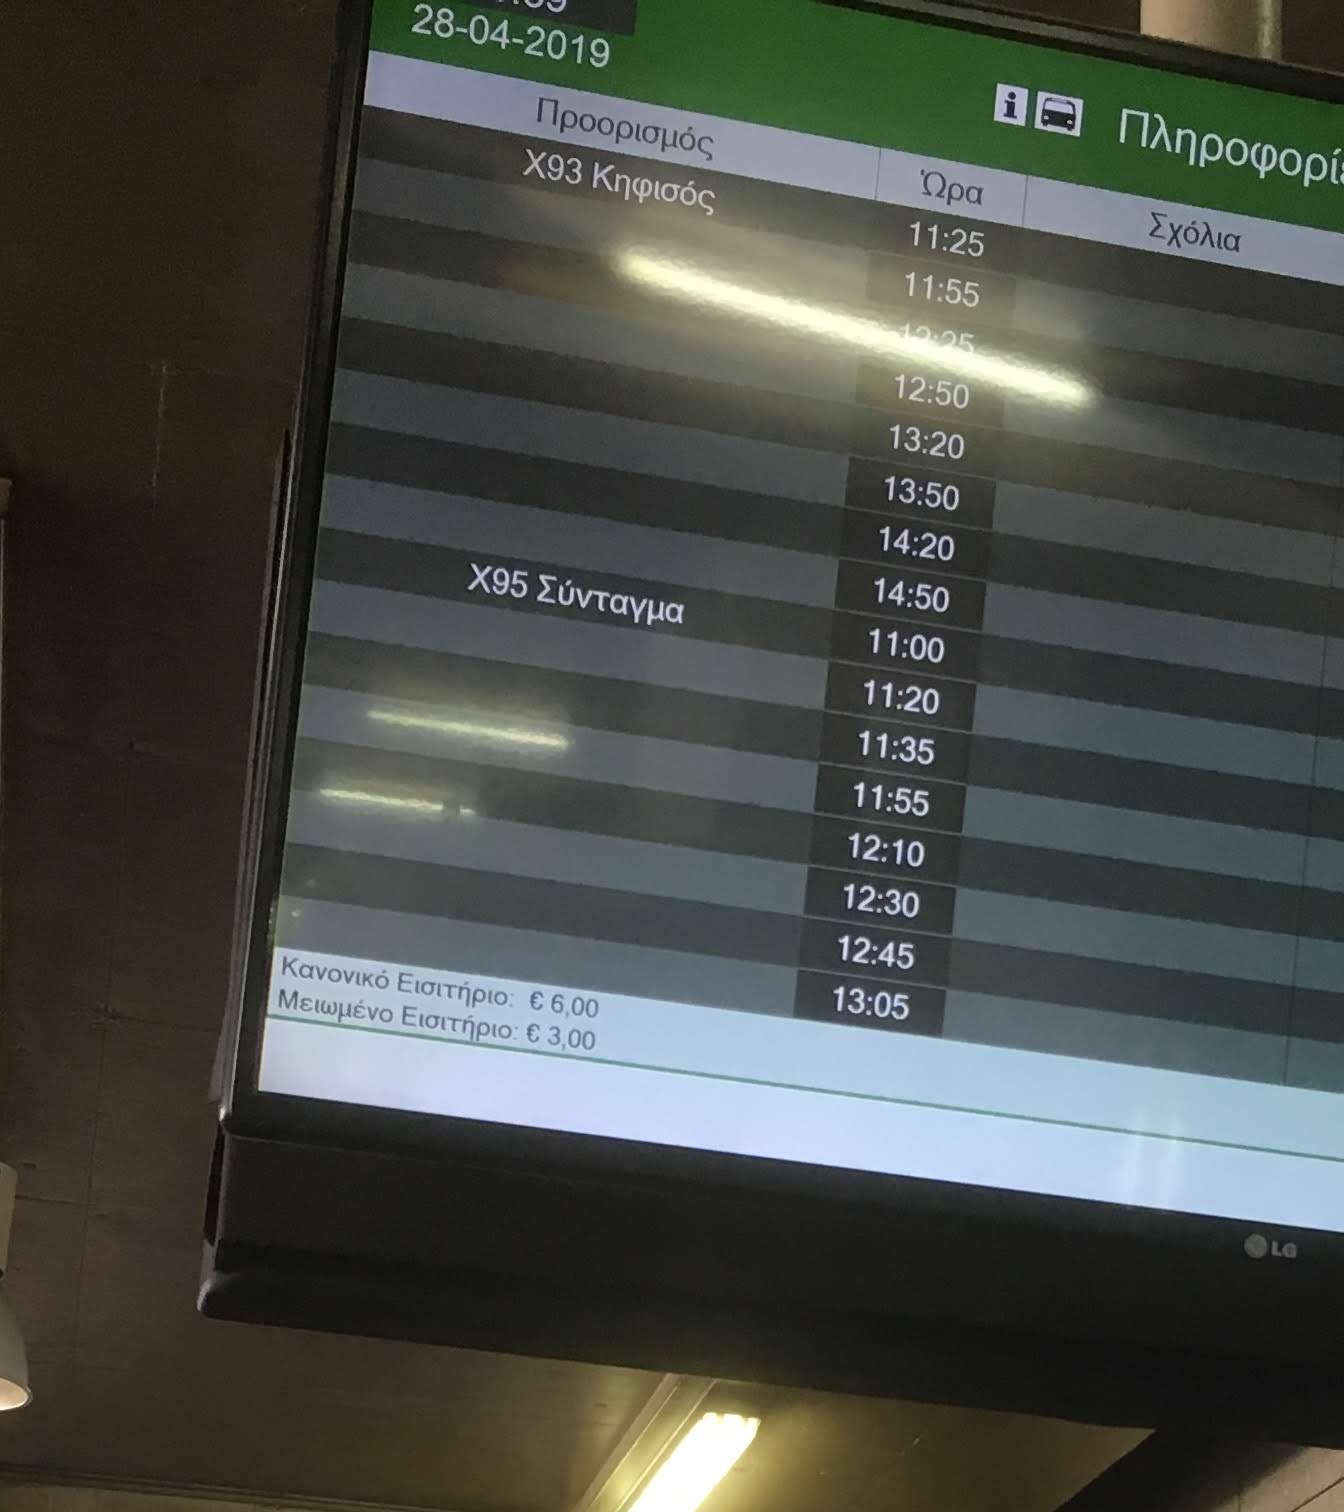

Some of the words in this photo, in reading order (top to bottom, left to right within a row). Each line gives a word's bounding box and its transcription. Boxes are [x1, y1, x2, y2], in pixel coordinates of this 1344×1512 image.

[411, 3, 611, 68] 28-04-2019
[537, 97, 714, 160] Προορισμός
[592, 162, 717, 216] Κηφισός
[920, 169, 984, 206] Ώρα
[909, 221, 985, 257] 11:25
[1149, 212, 1241, 254] Σχόλια
[905, 271, 980, 307] 11:55
[894, 374, 969, 409] 12:50
[889, 424, 965, 459] 13:20
[884, 475, 960, 511] 13:50
[879, 526, 955, 562] 14:20
[536, 574, 685, 626] Σύνταγμα
[873, 577, 950, 613] 14:50
[868, 629, 945, 664] 11:00
[863, 680, 940, 716] 11:20
[858, 730, 936, 767] 11:35
[853, 782, 931, 818] 11:55
[847, 833, 926, 868] 12:10
[842, 883, 920, 919] 12:30
[837, 934, 915, 971] 12:45
[280, 956, 390, 990] Κανονικό
[396, 973, 514, 1010] Εισιτήριο:
[550, 993, 599, 1020] 6,00
[832, 985, 910, 1022] 13:05
[278, 990, 394, 1024] Μειωμένο
[401, 1006, 518, 1043] Εισιτήριο:
[546, 1026, 596, 1052] 3,00
[1271, 1240, 1298, 1259] LG
